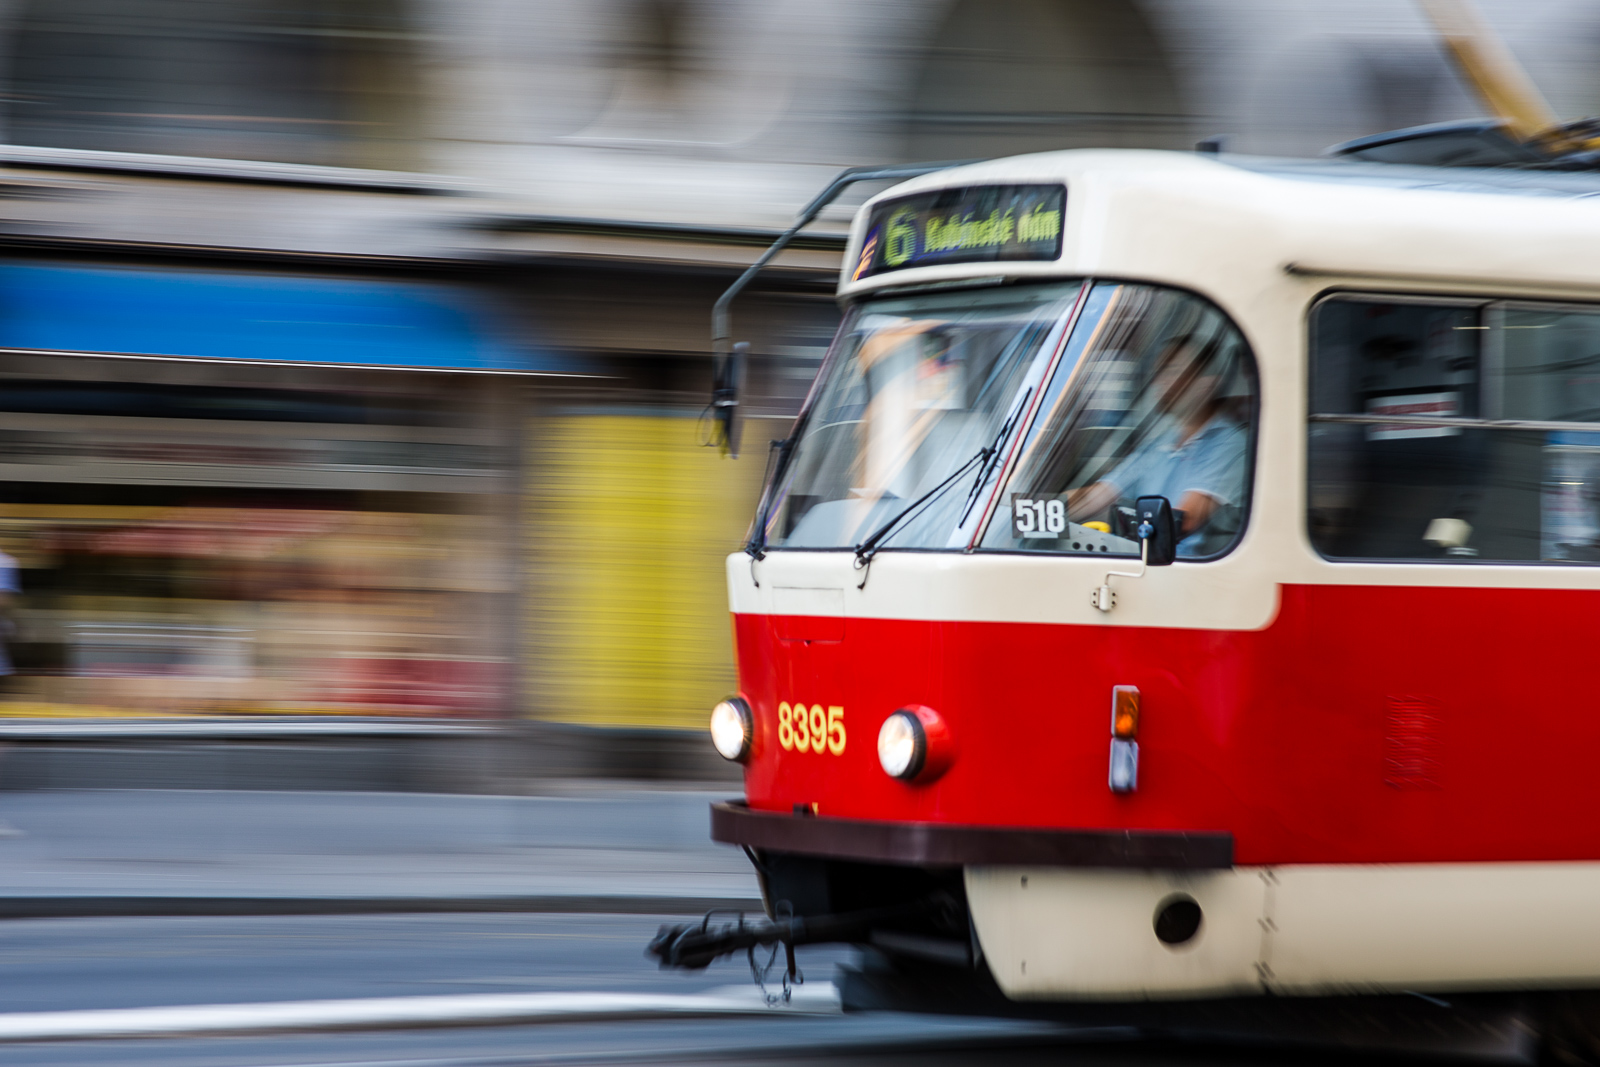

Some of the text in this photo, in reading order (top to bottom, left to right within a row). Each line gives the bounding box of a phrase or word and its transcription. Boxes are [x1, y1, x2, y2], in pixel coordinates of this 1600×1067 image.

[884, 206, 916, 266] 6
[1015, 499, 1065, 533] 518
[778, 701, 846, 756] 8395
